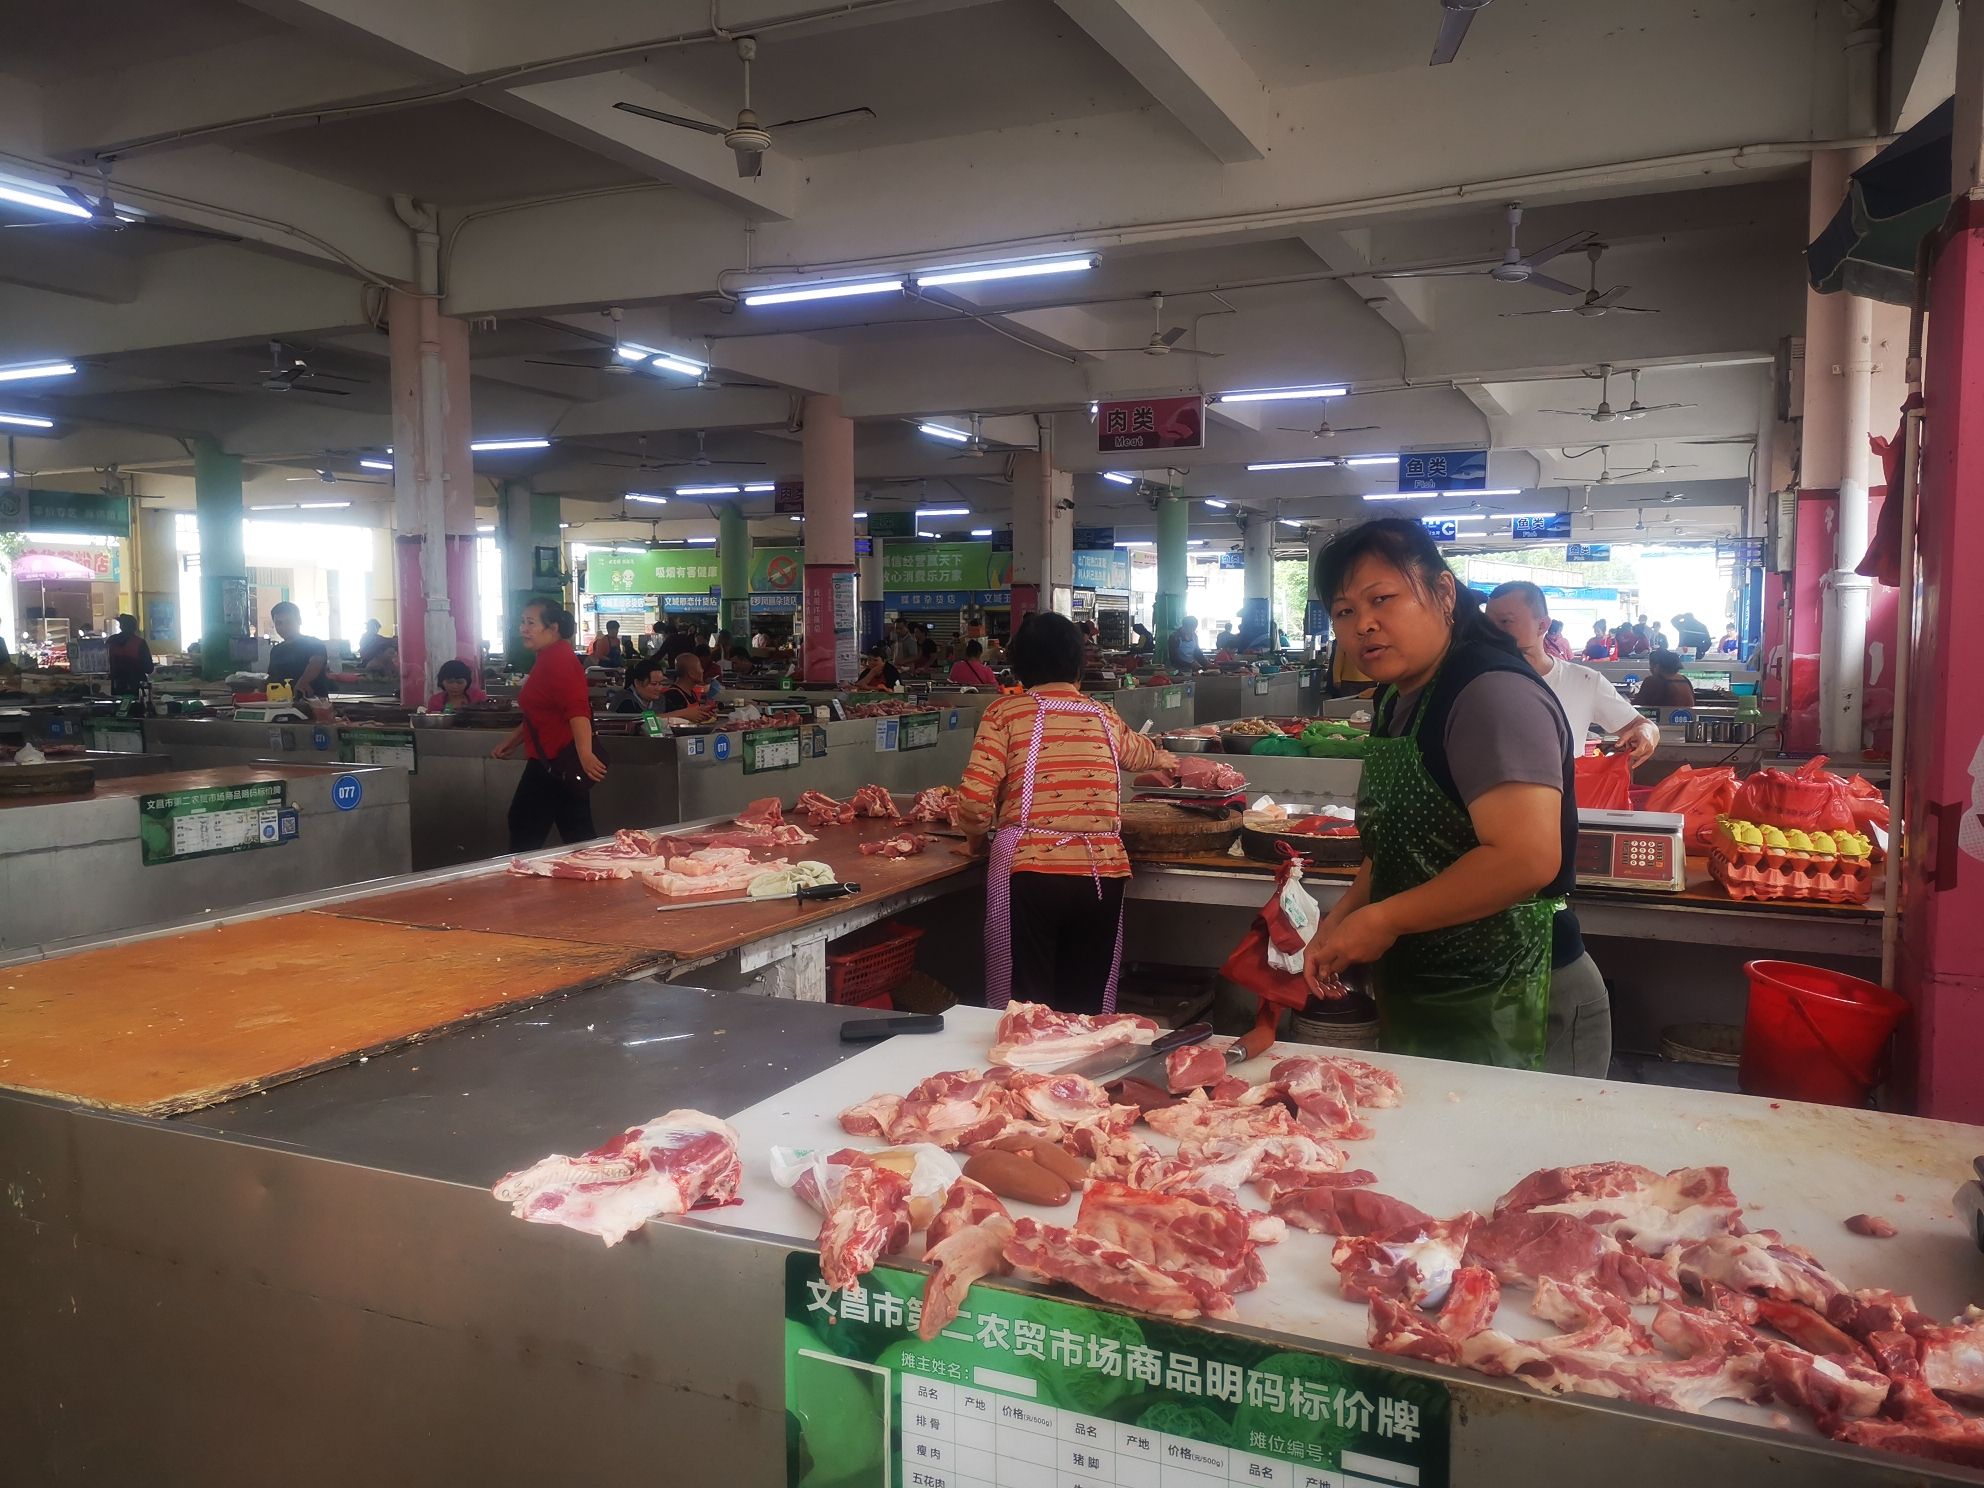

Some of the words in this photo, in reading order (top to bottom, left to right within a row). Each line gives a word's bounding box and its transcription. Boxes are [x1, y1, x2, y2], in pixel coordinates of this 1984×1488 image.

[1107, 406, 1154, 432] 肉类
[1115, 436, 1144, 447] Meat
[1405, 456, 1447, 478] 鱼类
[1414, 479, 1436, 489] Fish
[1516, 517, 1545, 531] 鱼类
[655, 566, 718, 578] 吸烟有害健康
[338, 786, 355, 799] 077
[916, 1414, 941, 1430] 排骨
[918, 1385, 939, 1400] 品名
[964, 1396, 986, 1411] 产地
[1075, 1423, 1098, 1438] 品名
[1126, 1435, 1150, 1451] 产地
[1249, 1463, 1273, 1480] 品名
[916, 1444, 941, 1460] 瘦肉
[1073, 1452, 1100, 1470] 猪脚
[912, 1471, 946, 1488] 五花肉
